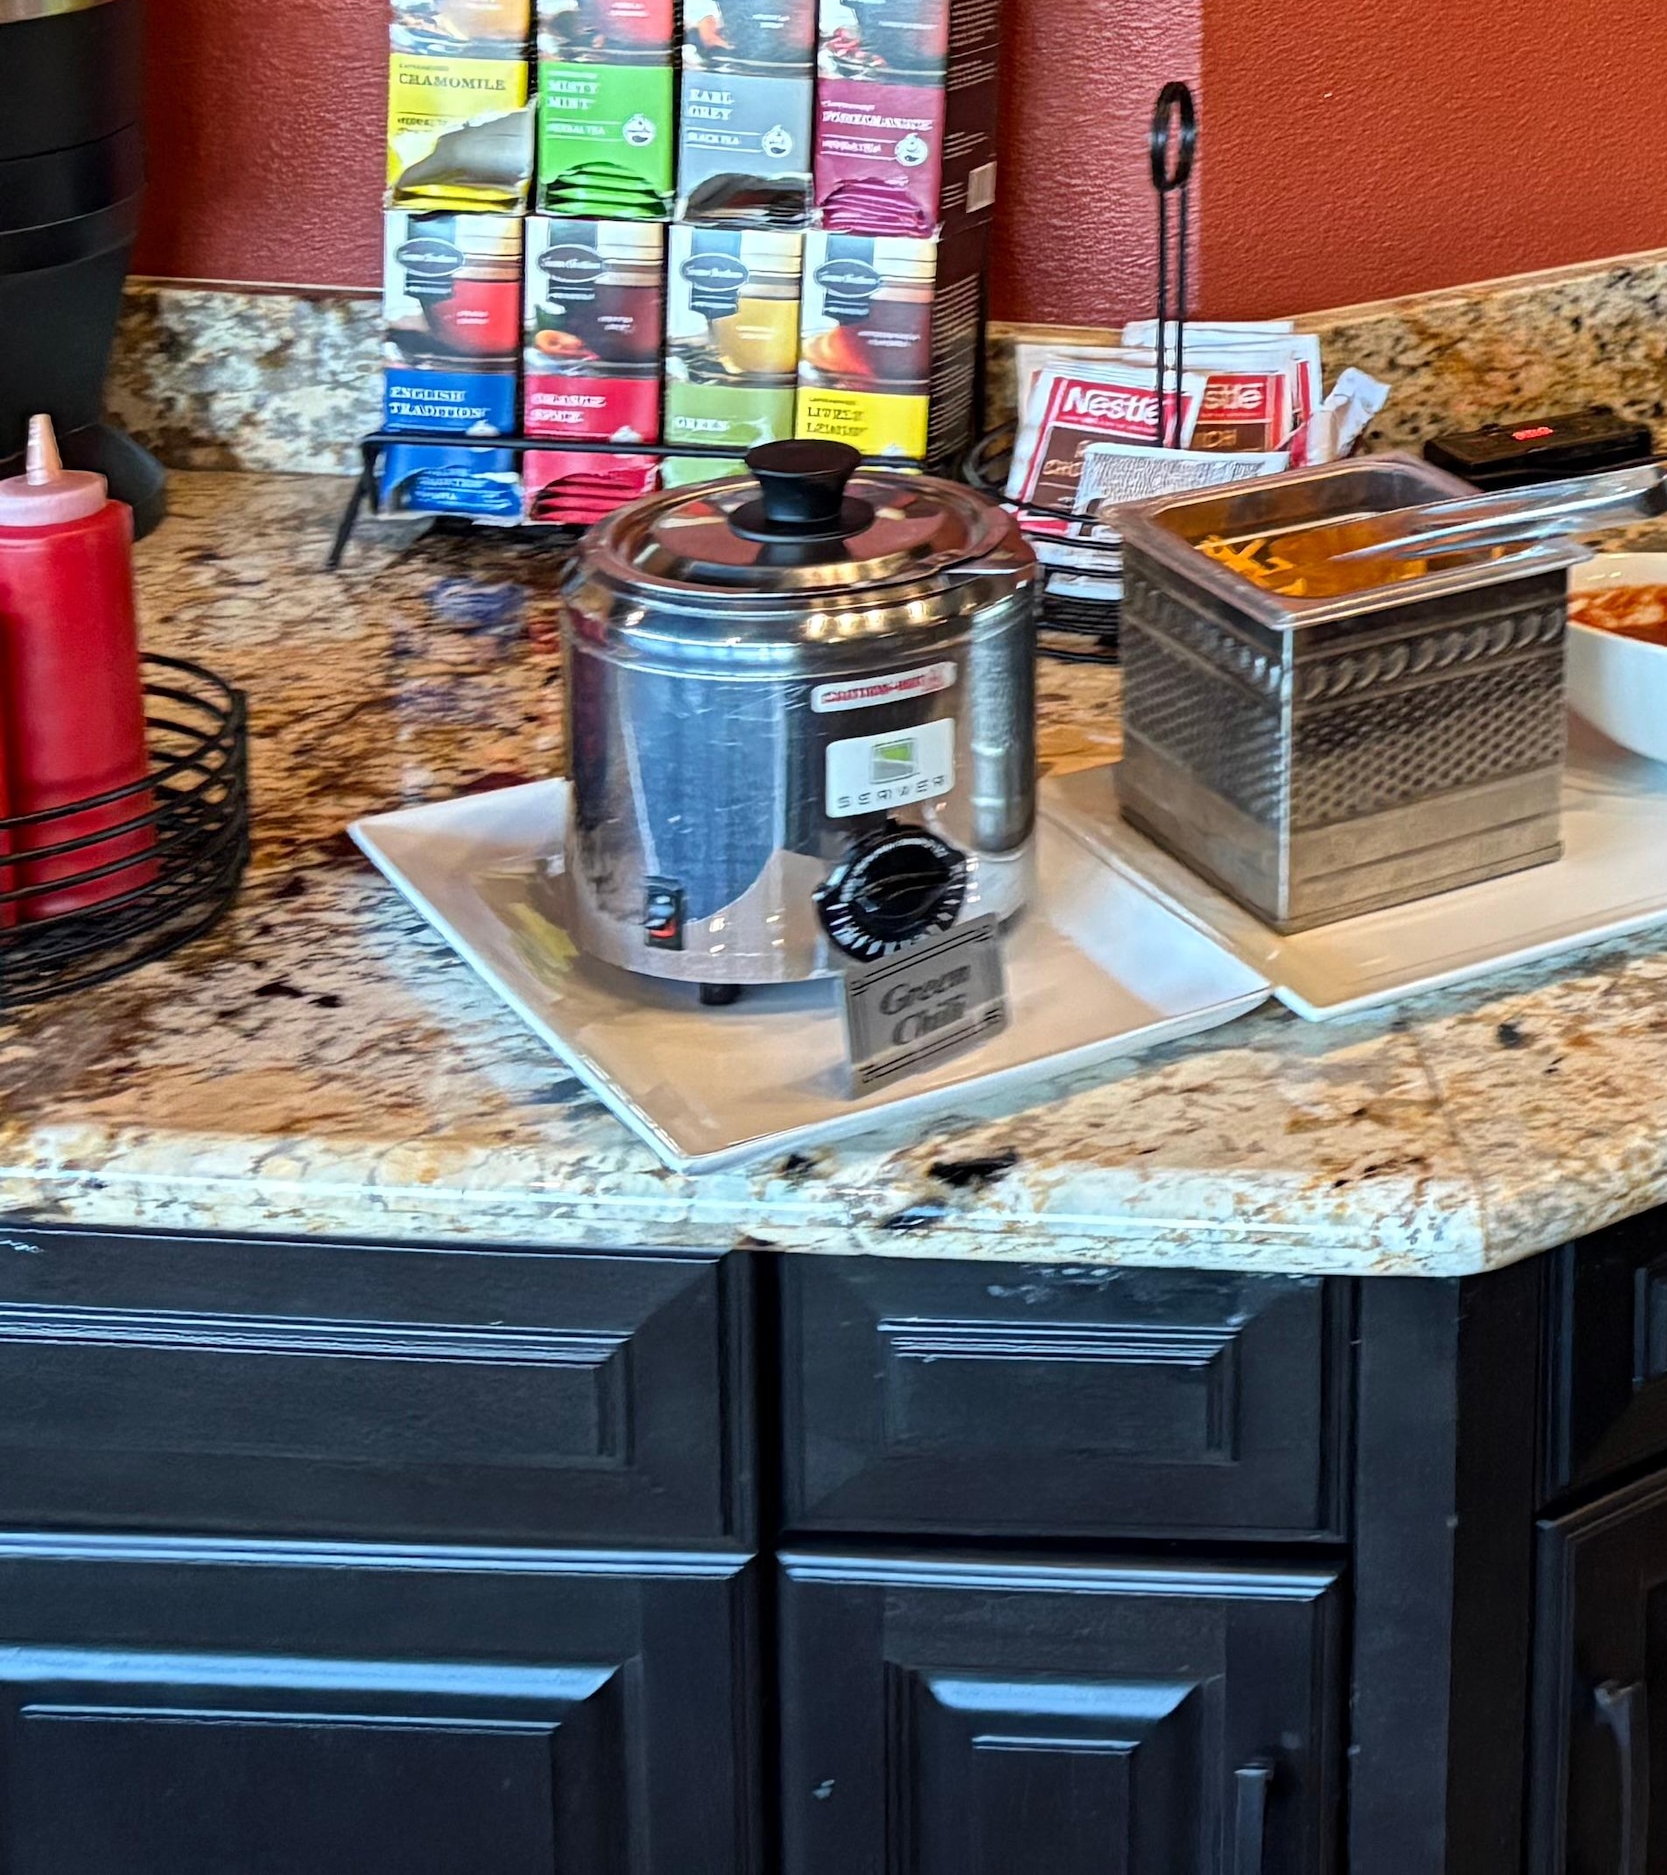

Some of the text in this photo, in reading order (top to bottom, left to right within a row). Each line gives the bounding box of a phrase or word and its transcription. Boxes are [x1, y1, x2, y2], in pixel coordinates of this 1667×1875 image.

[399, 72, 506, 91] CHAMOMILE
[688, 88, 735, 105] EARL
[688, 104, 734, 121] GREY
[390, 386, 466, 403] ENGLISH
[388, 402, 492, 419] TRADITION
[880, 965, 972, 1016] Green
